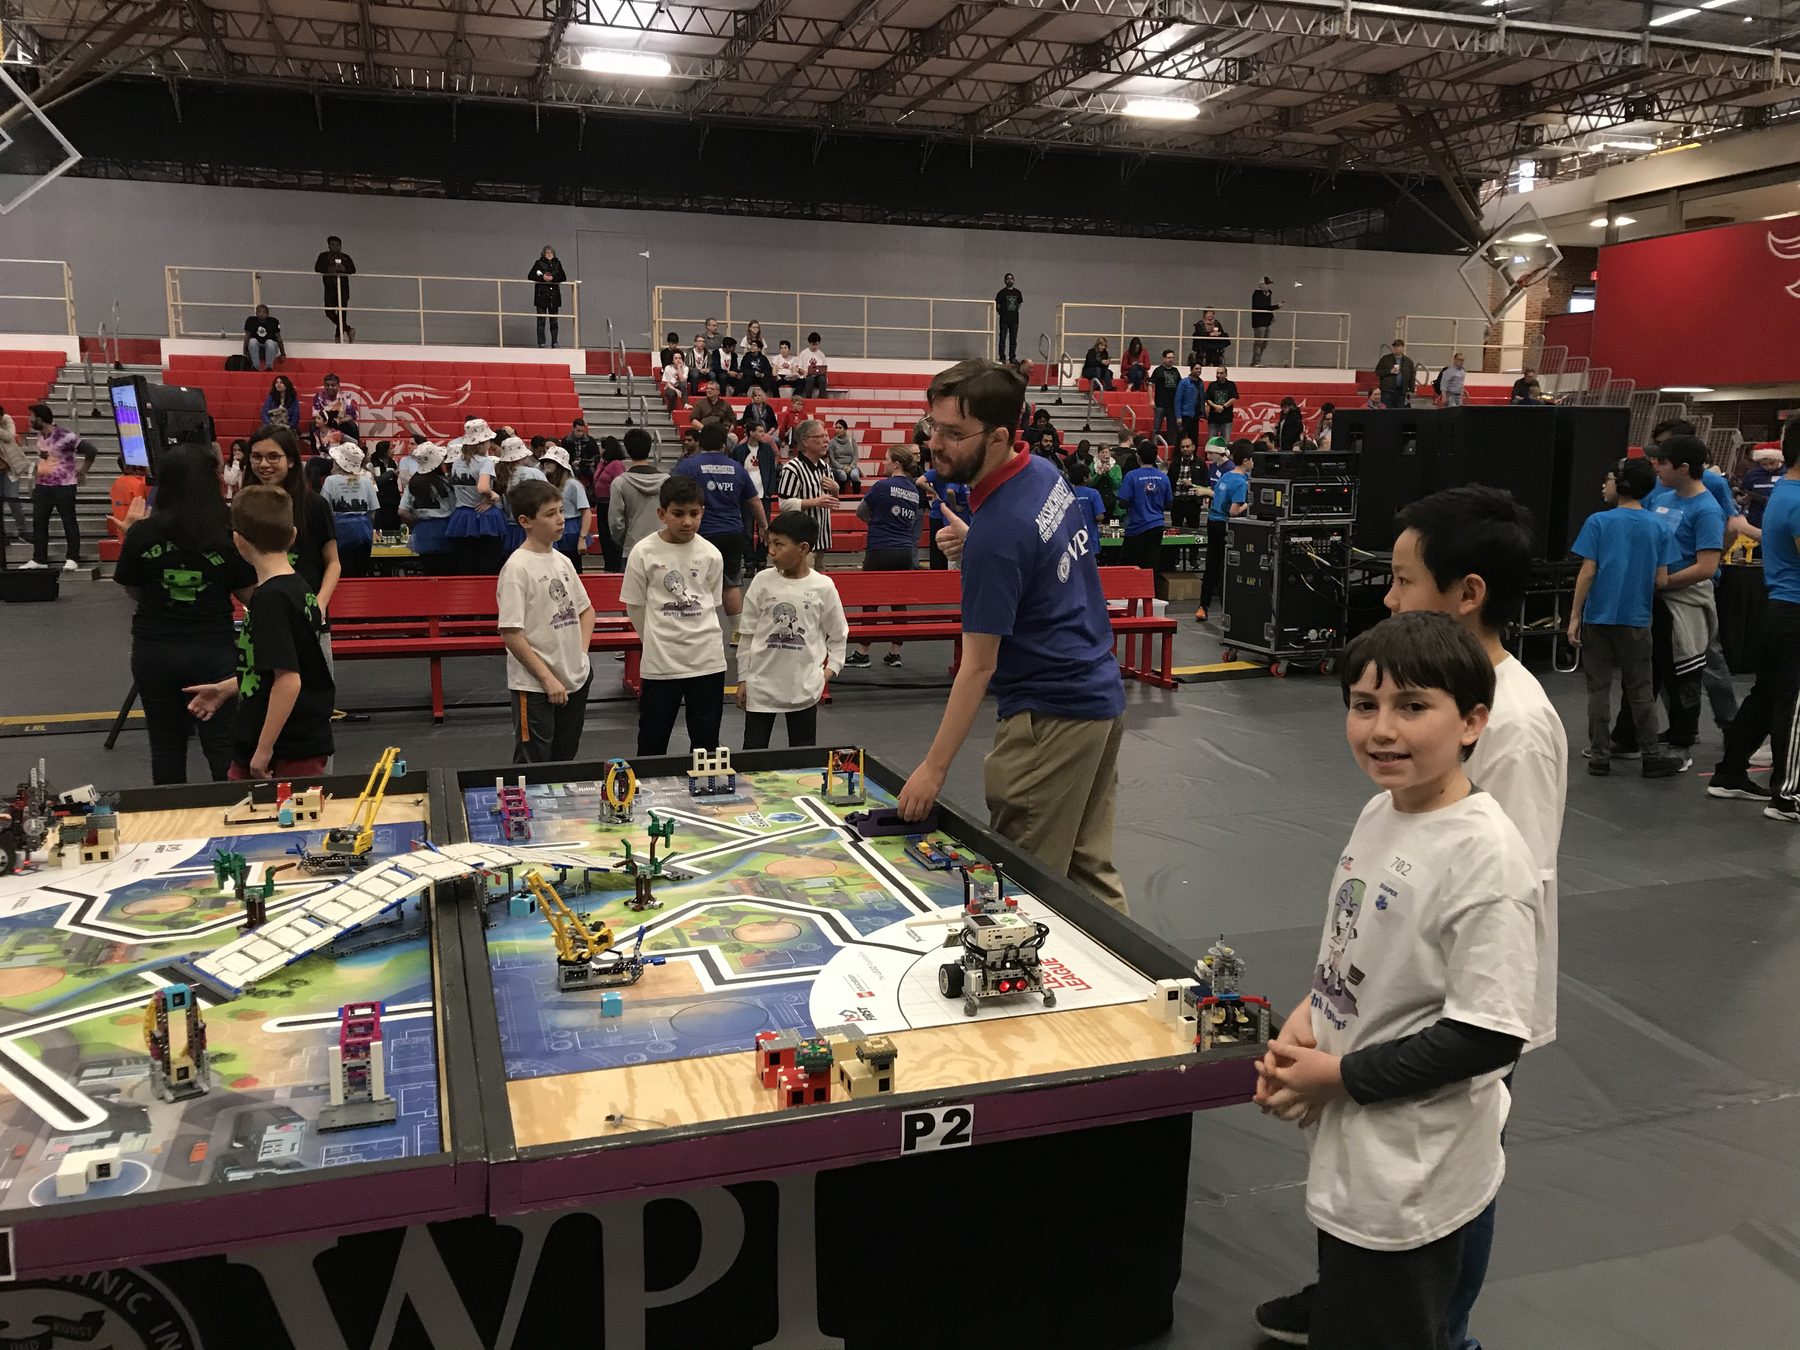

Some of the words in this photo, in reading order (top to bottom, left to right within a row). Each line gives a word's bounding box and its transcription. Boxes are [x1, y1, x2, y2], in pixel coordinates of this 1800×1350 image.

[716, 482, 734, 491] WPI
[1391, 856, 1412, 877] 702
[1040, 957, 1093, 991] LEAGUE
[904, 1108, 971, 1151] P2
[226, 1170, 846, 1350] WPI
[53, 1321, 95, 1337] KUNST
